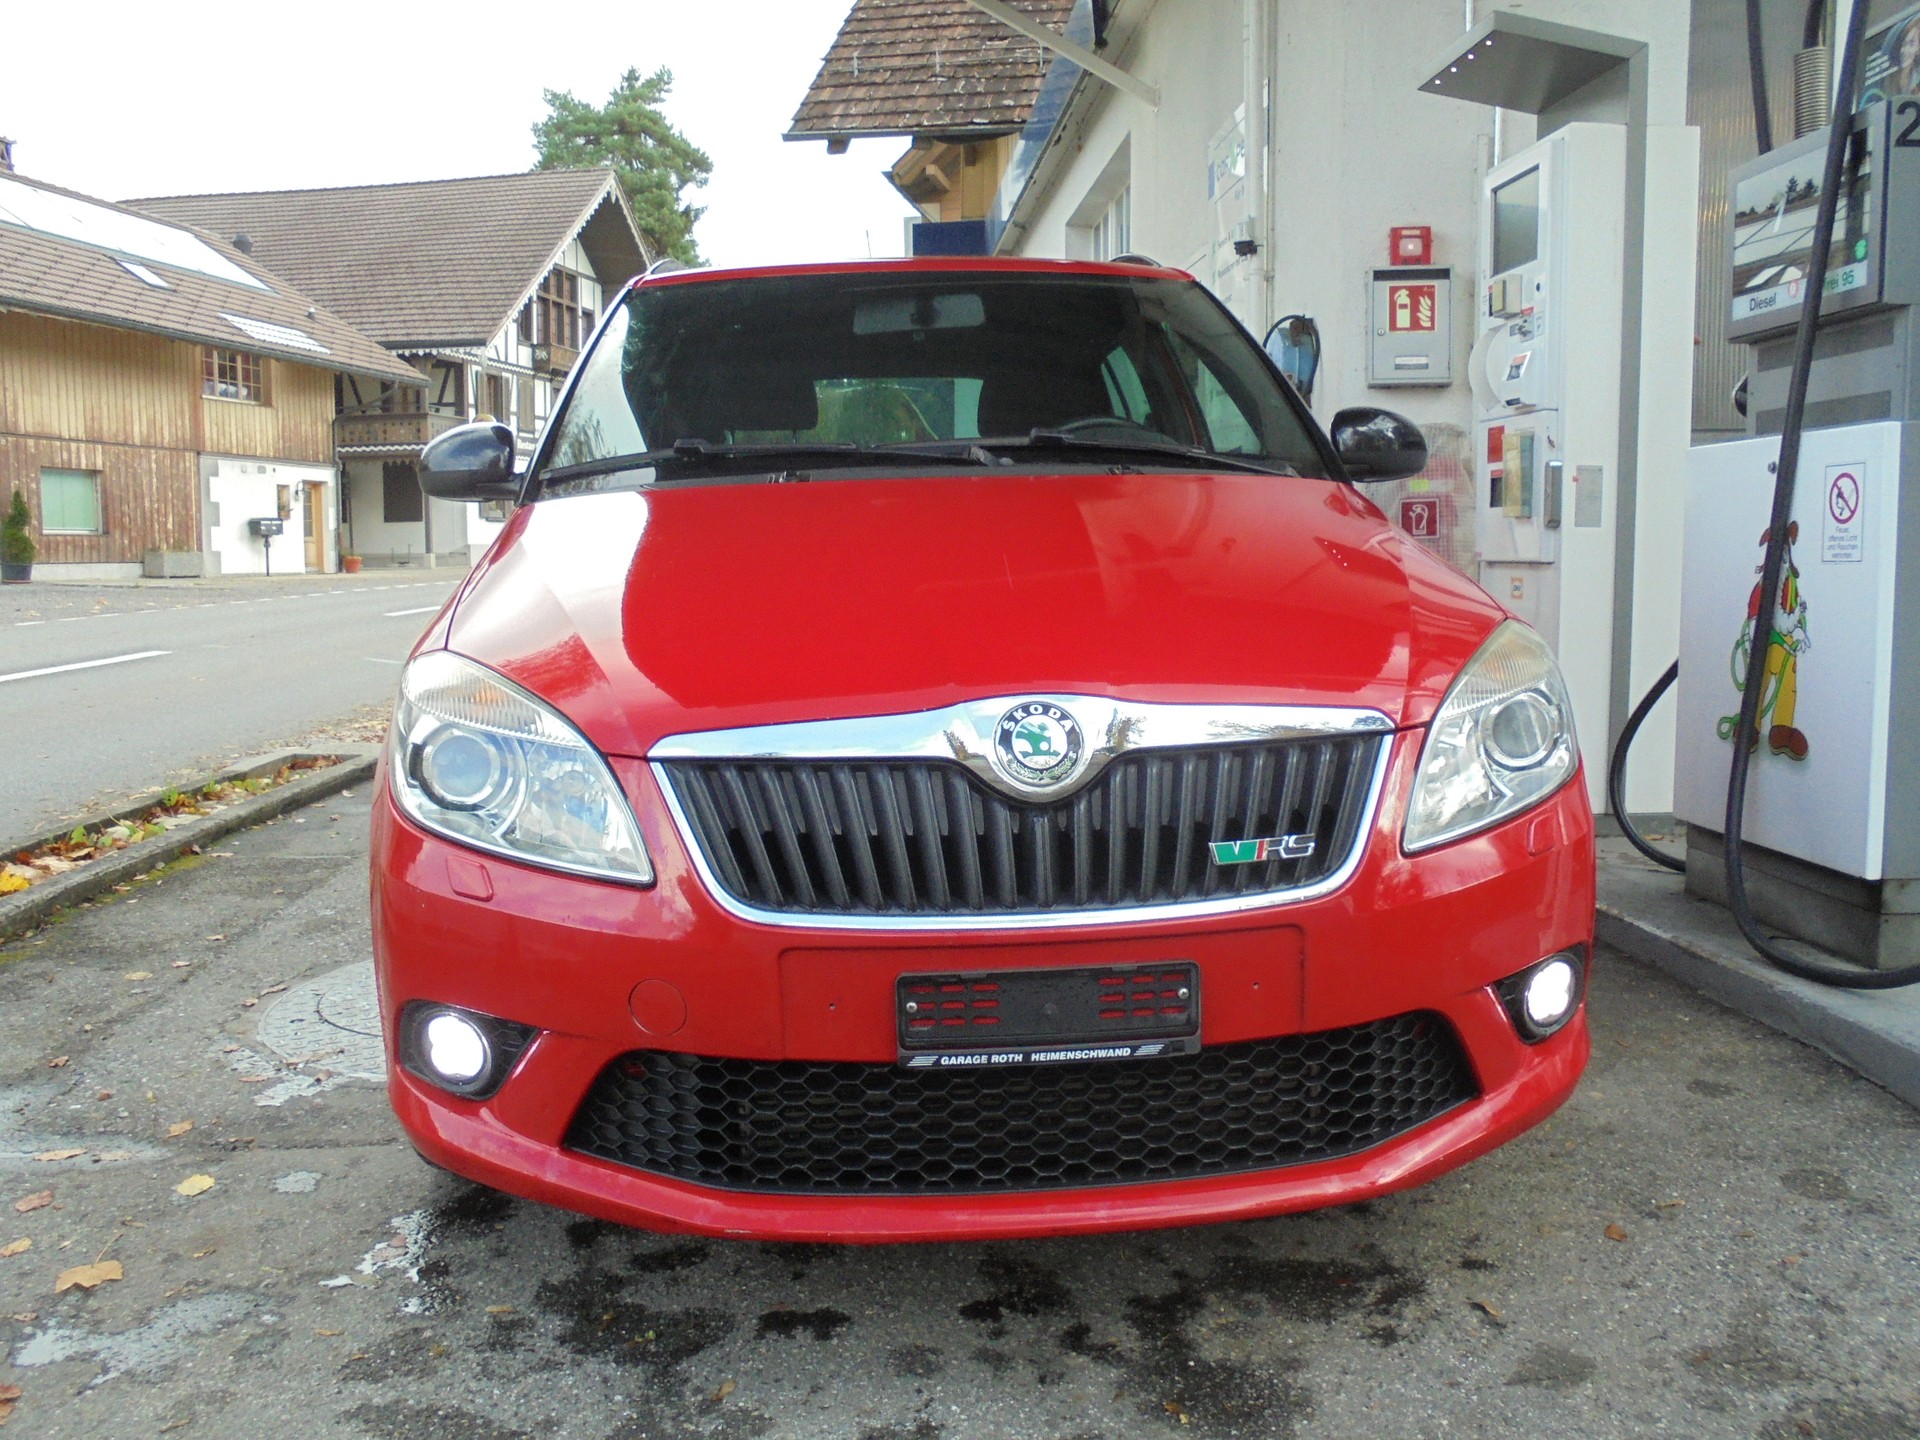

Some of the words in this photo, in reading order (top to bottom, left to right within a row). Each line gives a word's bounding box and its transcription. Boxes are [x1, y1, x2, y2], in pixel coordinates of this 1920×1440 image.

[1842, 269, 1855, 286] 95
[1749, 293, 1777, 312] Diesel
[940, 1054, 988, 1066] GARAGE
[991, 1053, 1024, 1064] ROTH
[1031, 1047, 1132, 1062] HEIMENSCHWAND
